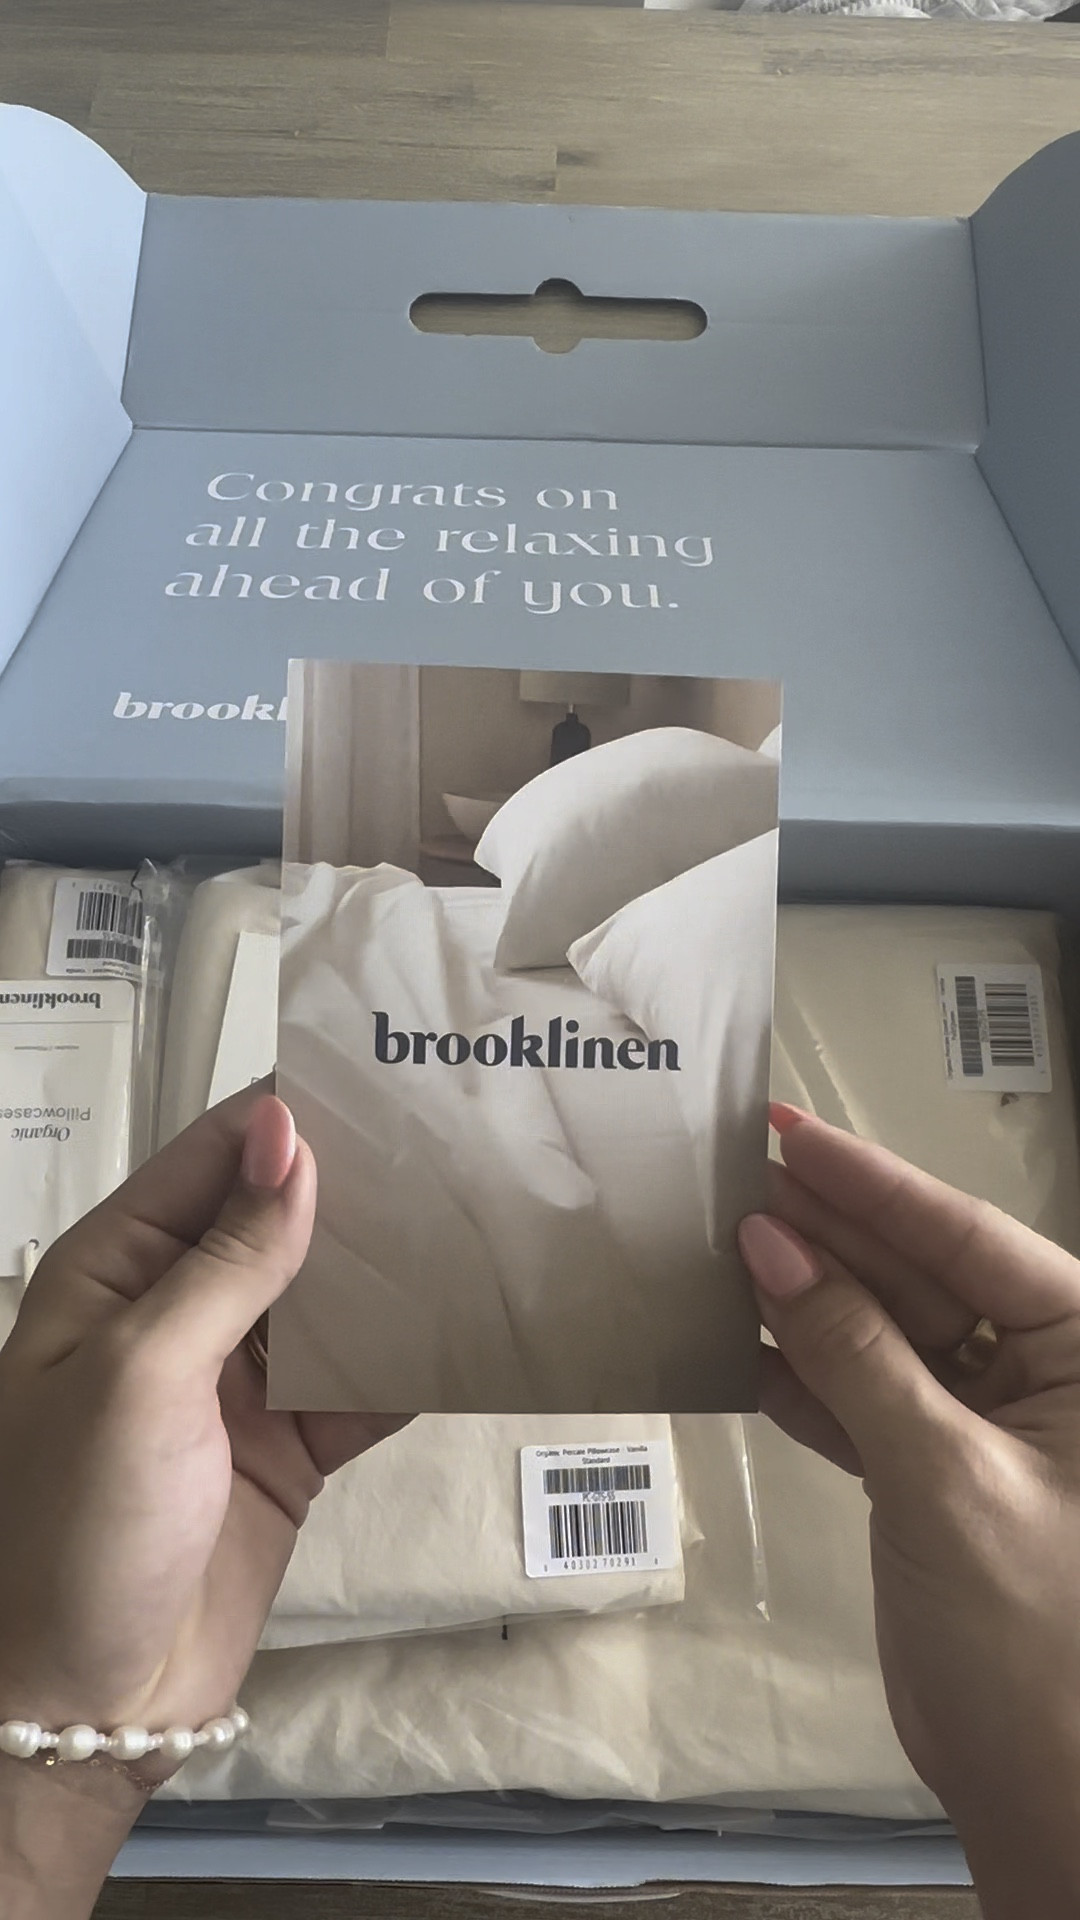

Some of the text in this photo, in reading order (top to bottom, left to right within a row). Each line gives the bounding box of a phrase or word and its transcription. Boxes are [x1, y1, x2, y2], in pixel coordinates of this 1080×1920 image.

[206, 471, 619, 512] Congrats on
[184, 516, 715, 567] all the relaxing
[164, 564, 680, 616] ahead of you.
[371, 1010, 682, 1072] brooklinen
[10, 1124, 71, 1142] Organic
